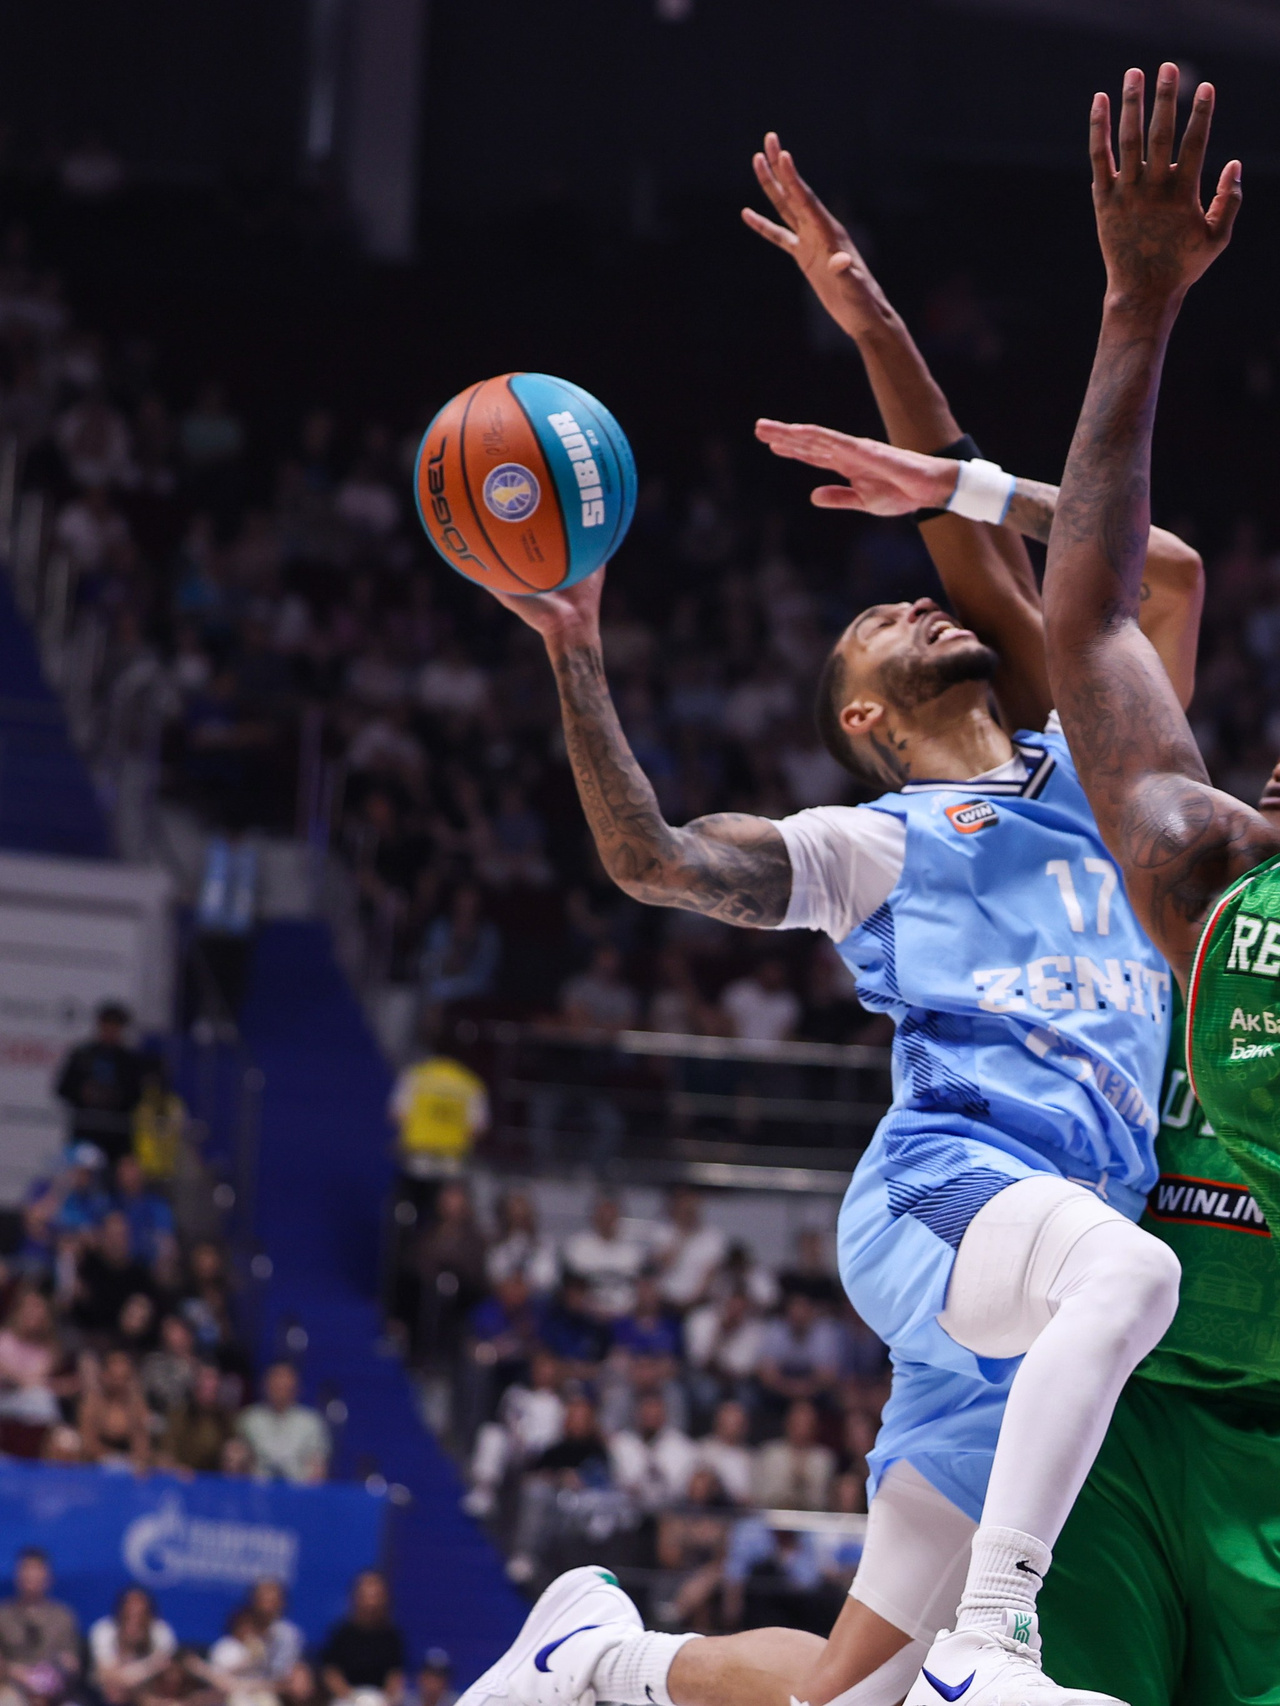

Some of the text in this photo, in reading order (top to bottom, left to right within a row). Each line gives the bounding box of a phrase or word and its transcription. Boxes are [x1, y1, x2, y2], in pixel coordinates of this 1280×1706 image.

[547, 411, 605, 528] SIBUR
[960, 804, 993, 823] WIN
[1046, 857, 1117, 935] 17
[973, 956, 1169, 1024] ZENIT
[1229, 1007, 1261, 1032] Ак
[1230, 1037, 1275, 1060] Банк
